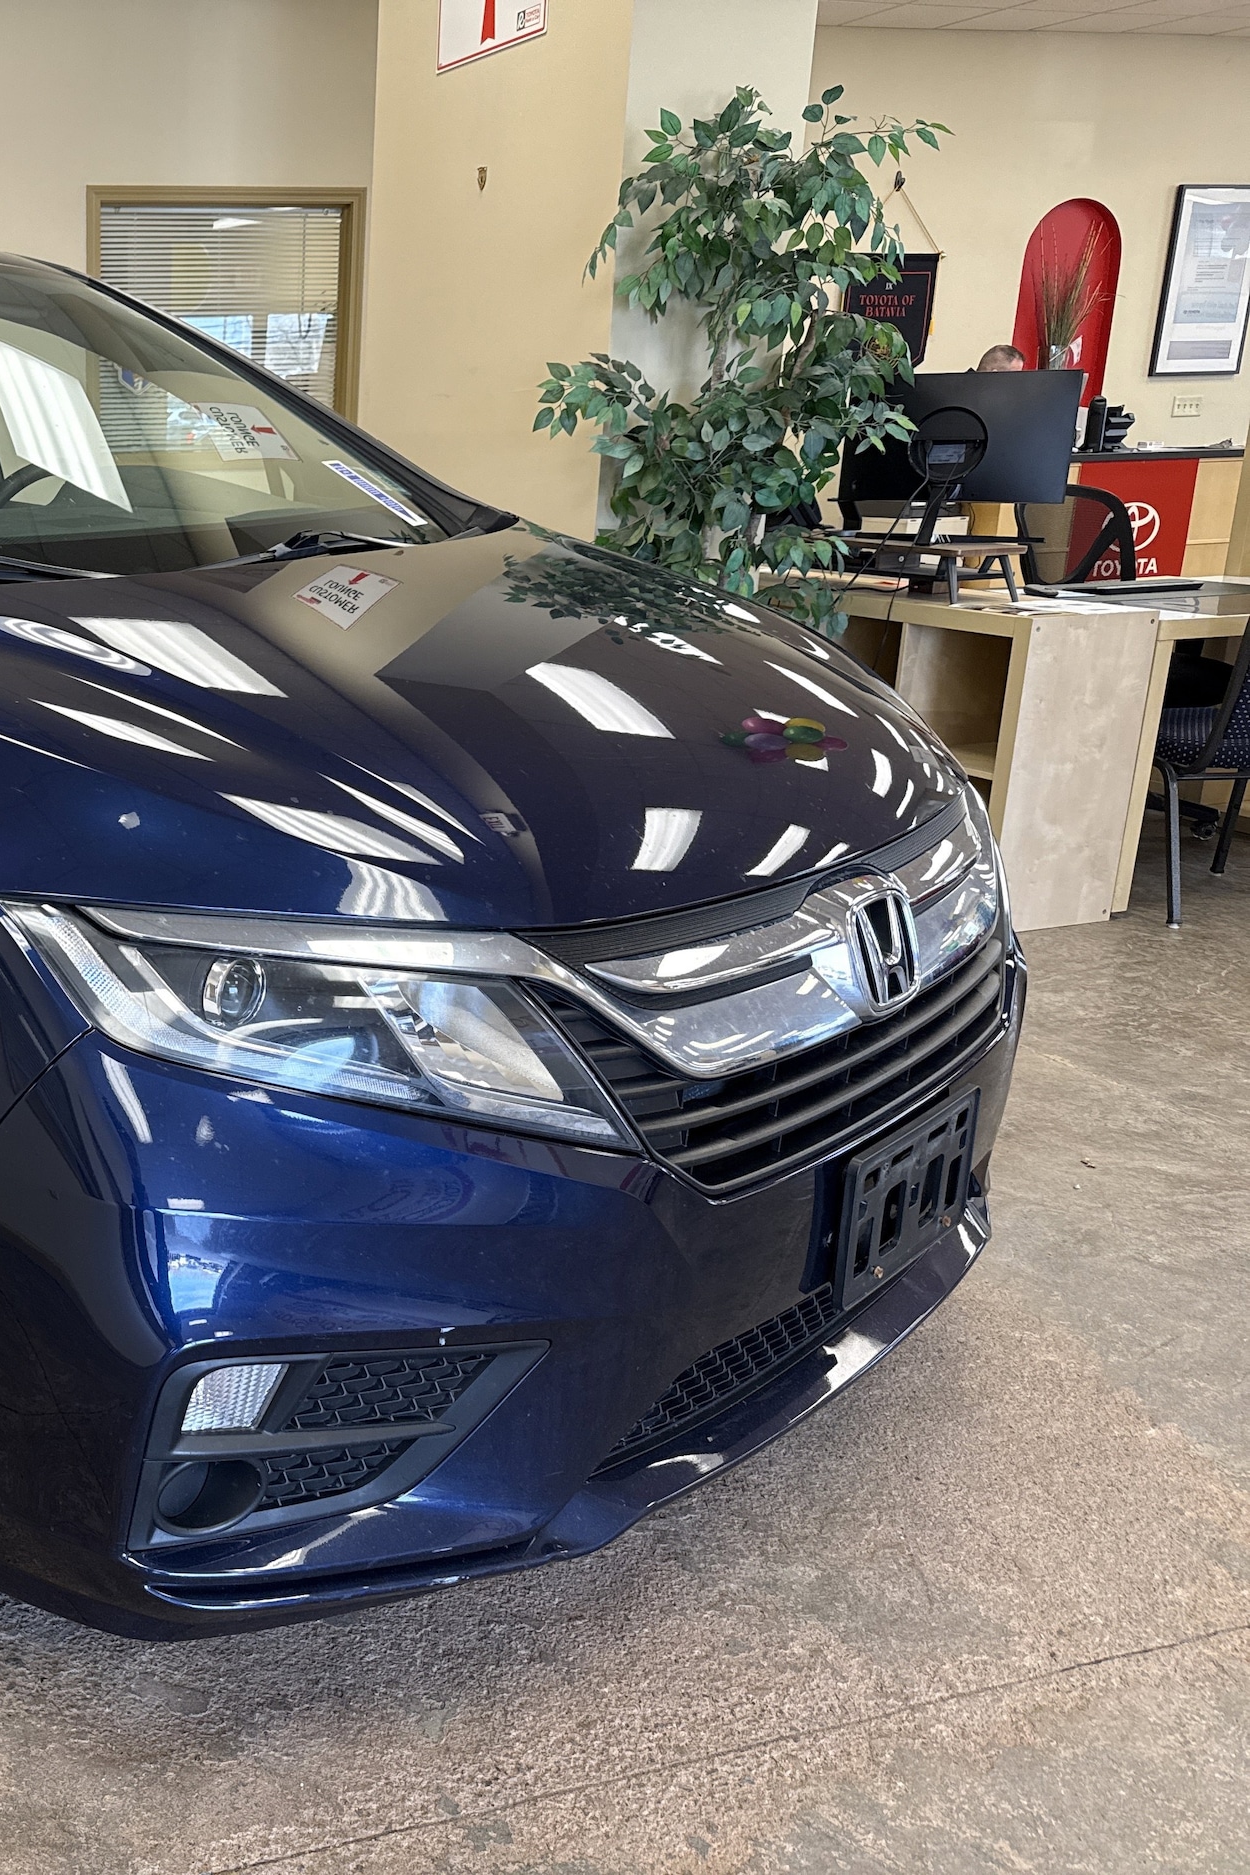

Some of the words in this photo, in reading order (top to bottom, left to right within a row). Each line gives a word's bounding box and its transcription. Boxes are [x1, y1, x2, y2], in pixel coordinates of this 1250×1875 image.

[859, 294, 898, 306] TOYOTA
[901, 294, 916, 306] OF
[865, 306, 906, 317] BATAVIA
[1093, 557, 1158, 577] TOYTA
